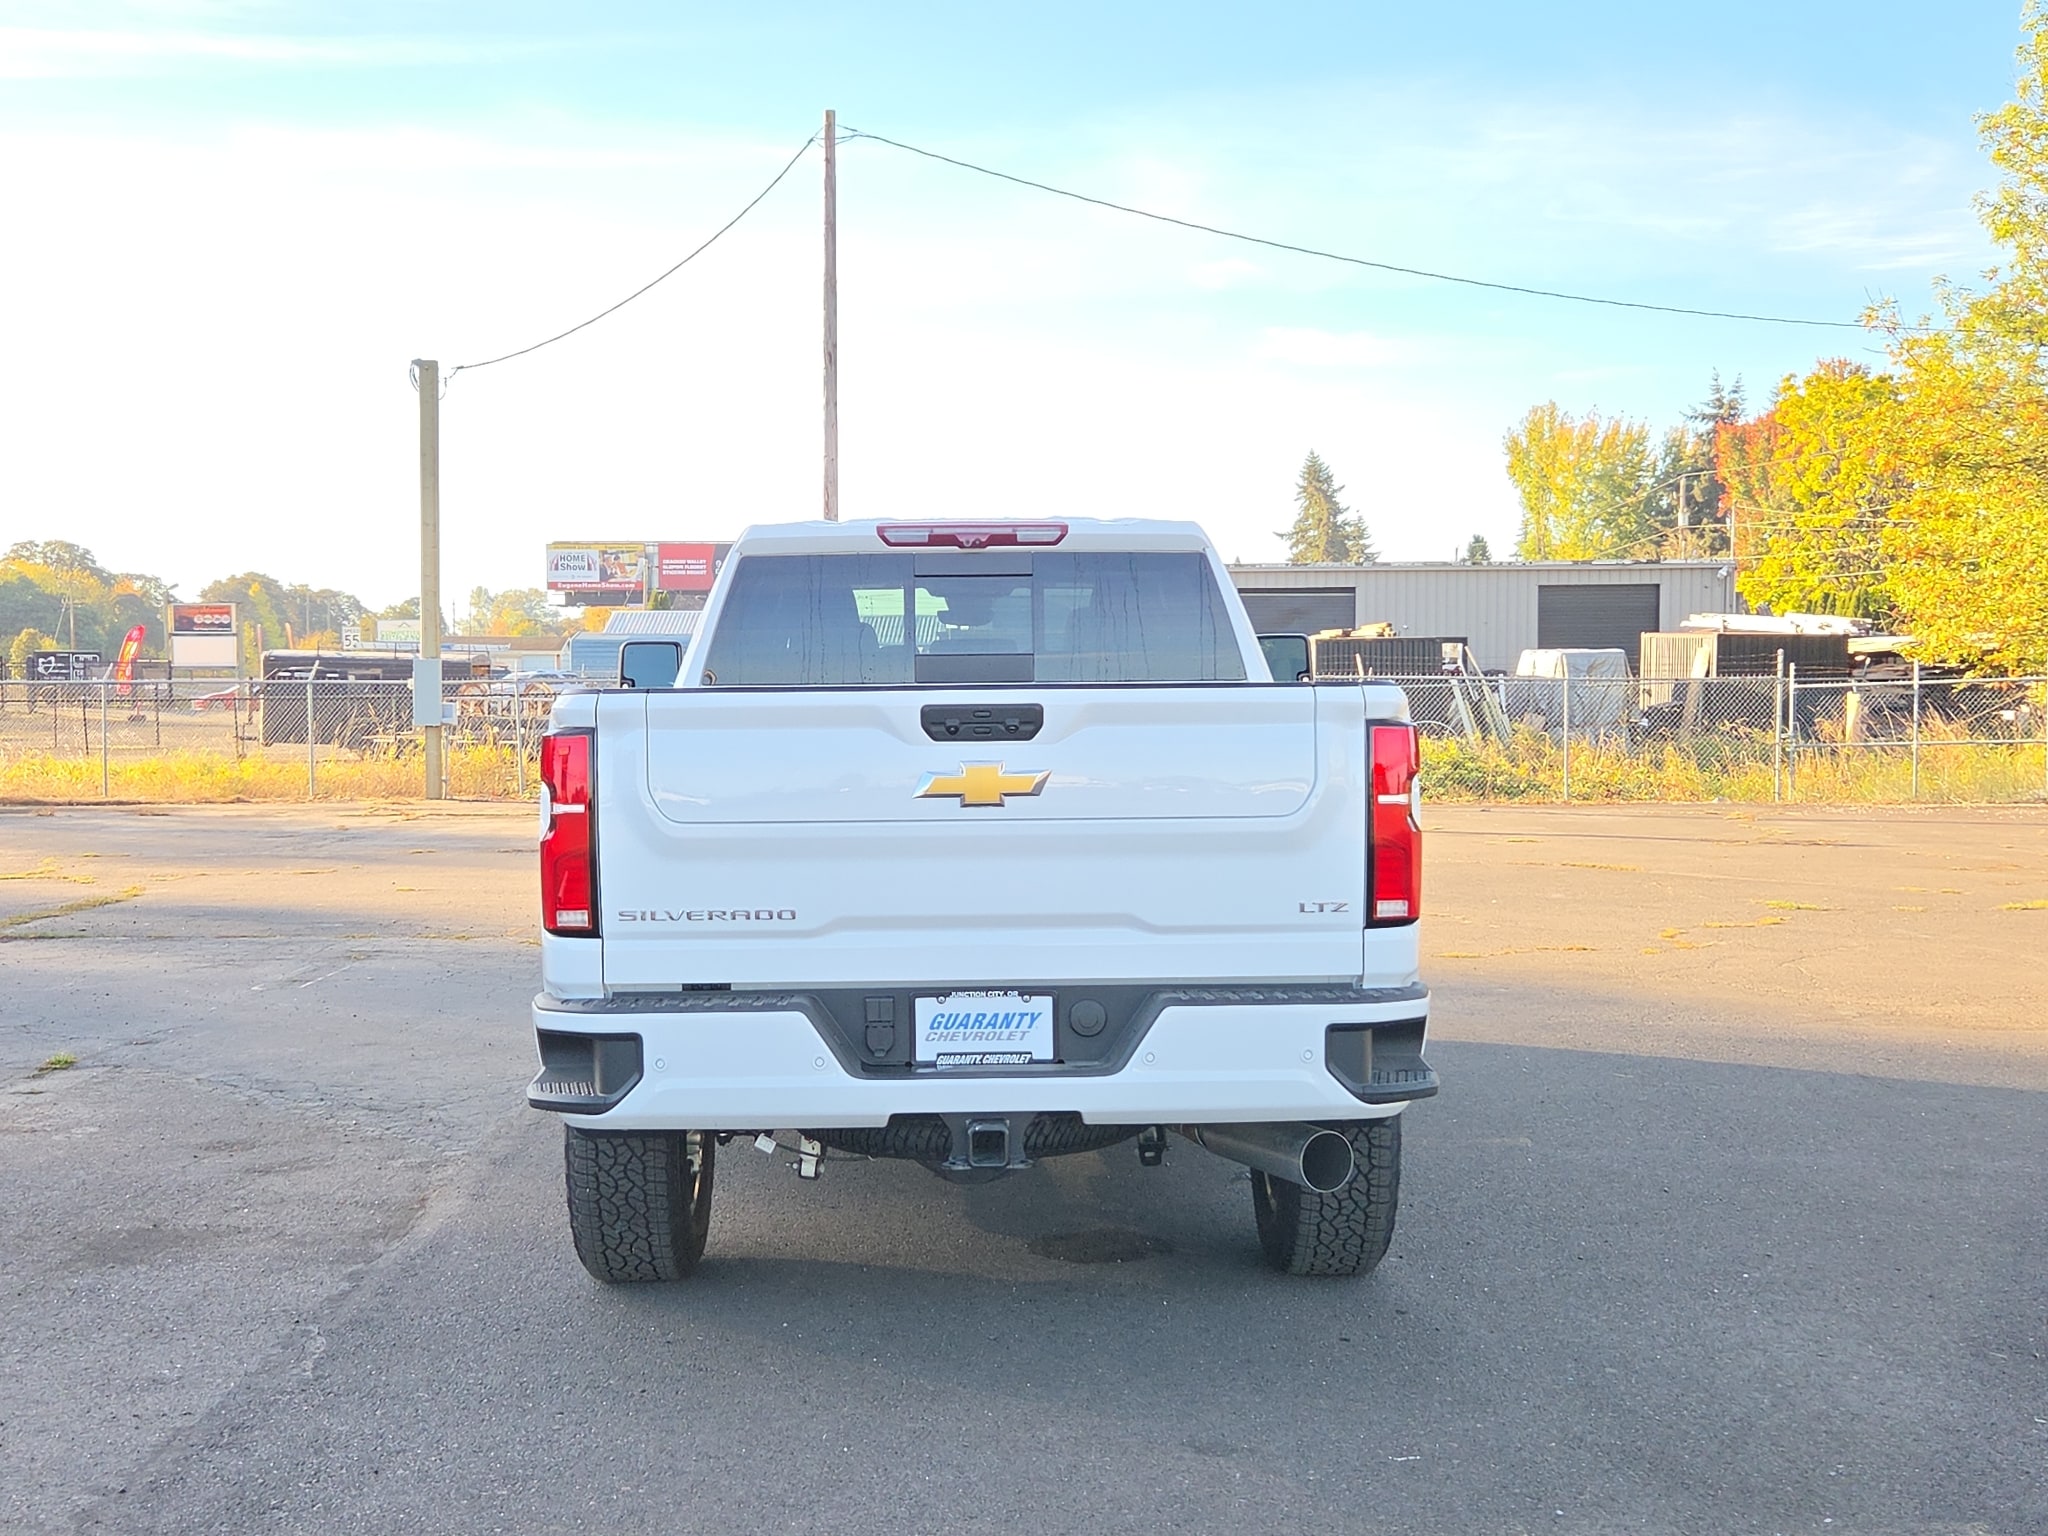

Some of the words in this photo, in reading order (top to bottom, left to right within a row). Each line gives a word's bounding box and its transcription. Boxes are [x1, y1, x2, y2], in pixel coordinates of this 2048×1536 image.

[560, 554, 586, 562] HOME
[560, 562, 586, 571] Show
[344, 634, 360, 648] 55
[1298, 902, 1349, 913] LTZ
[618, 909, 797, 922] SILVERADO
[1007, 990, 1019, 998] OR
[929, 1012, 1043, 1030] GUARANTY
[925, 1031, 1031, 1042] CHEVROLET
[982, 1053, 1032, 1065] CHEVROLET
